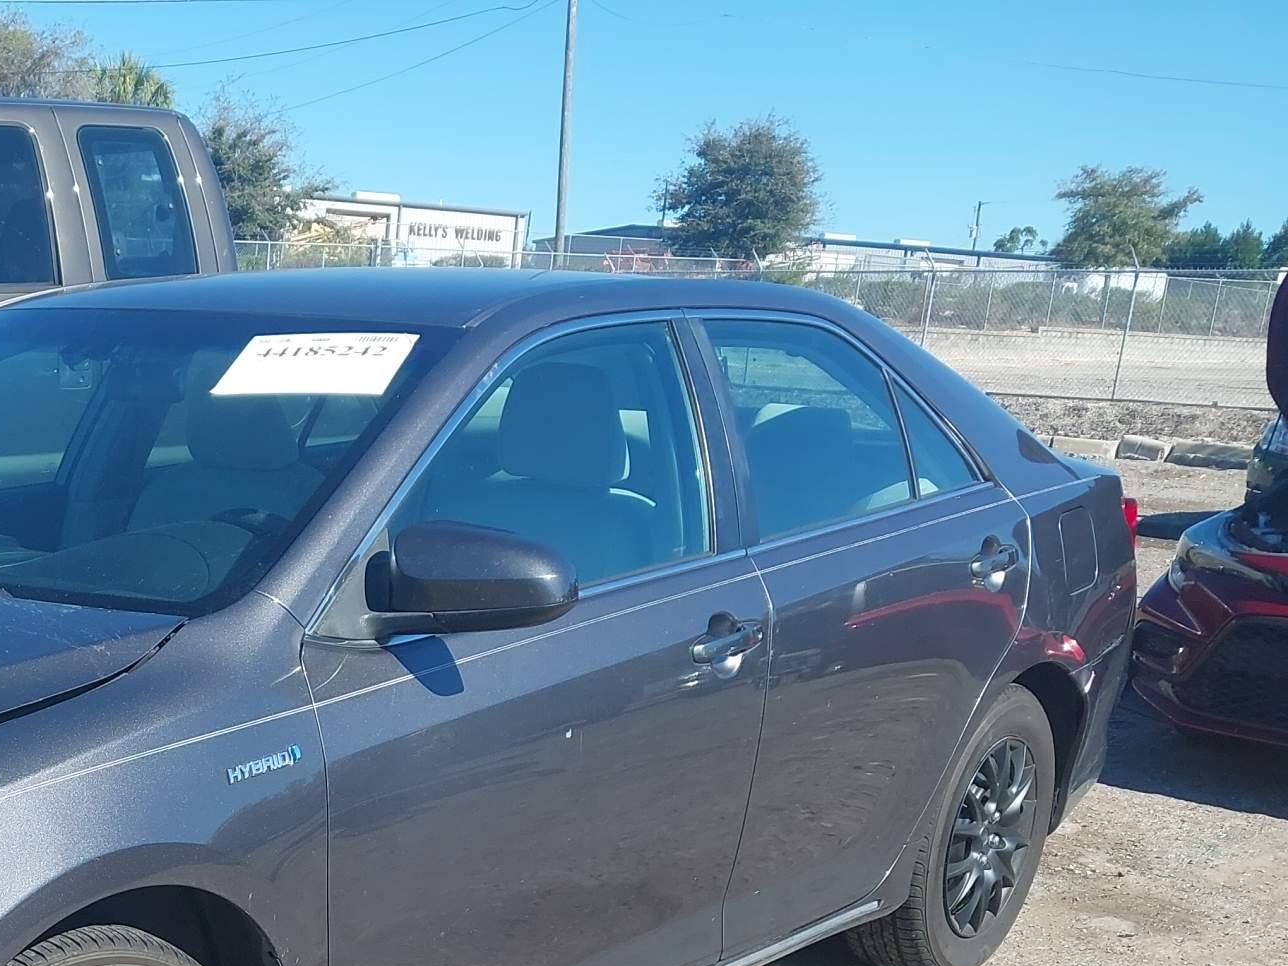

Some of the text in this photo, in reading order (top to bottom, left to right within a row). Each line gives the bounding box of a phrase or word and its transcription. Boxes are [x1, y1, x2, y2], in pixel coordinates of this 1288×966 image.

[409, 221, 502, 242] KELLY'S WELDING
[256, 345, 389, 358] 44185242
[226, 750, 292, 785] HYBRID
